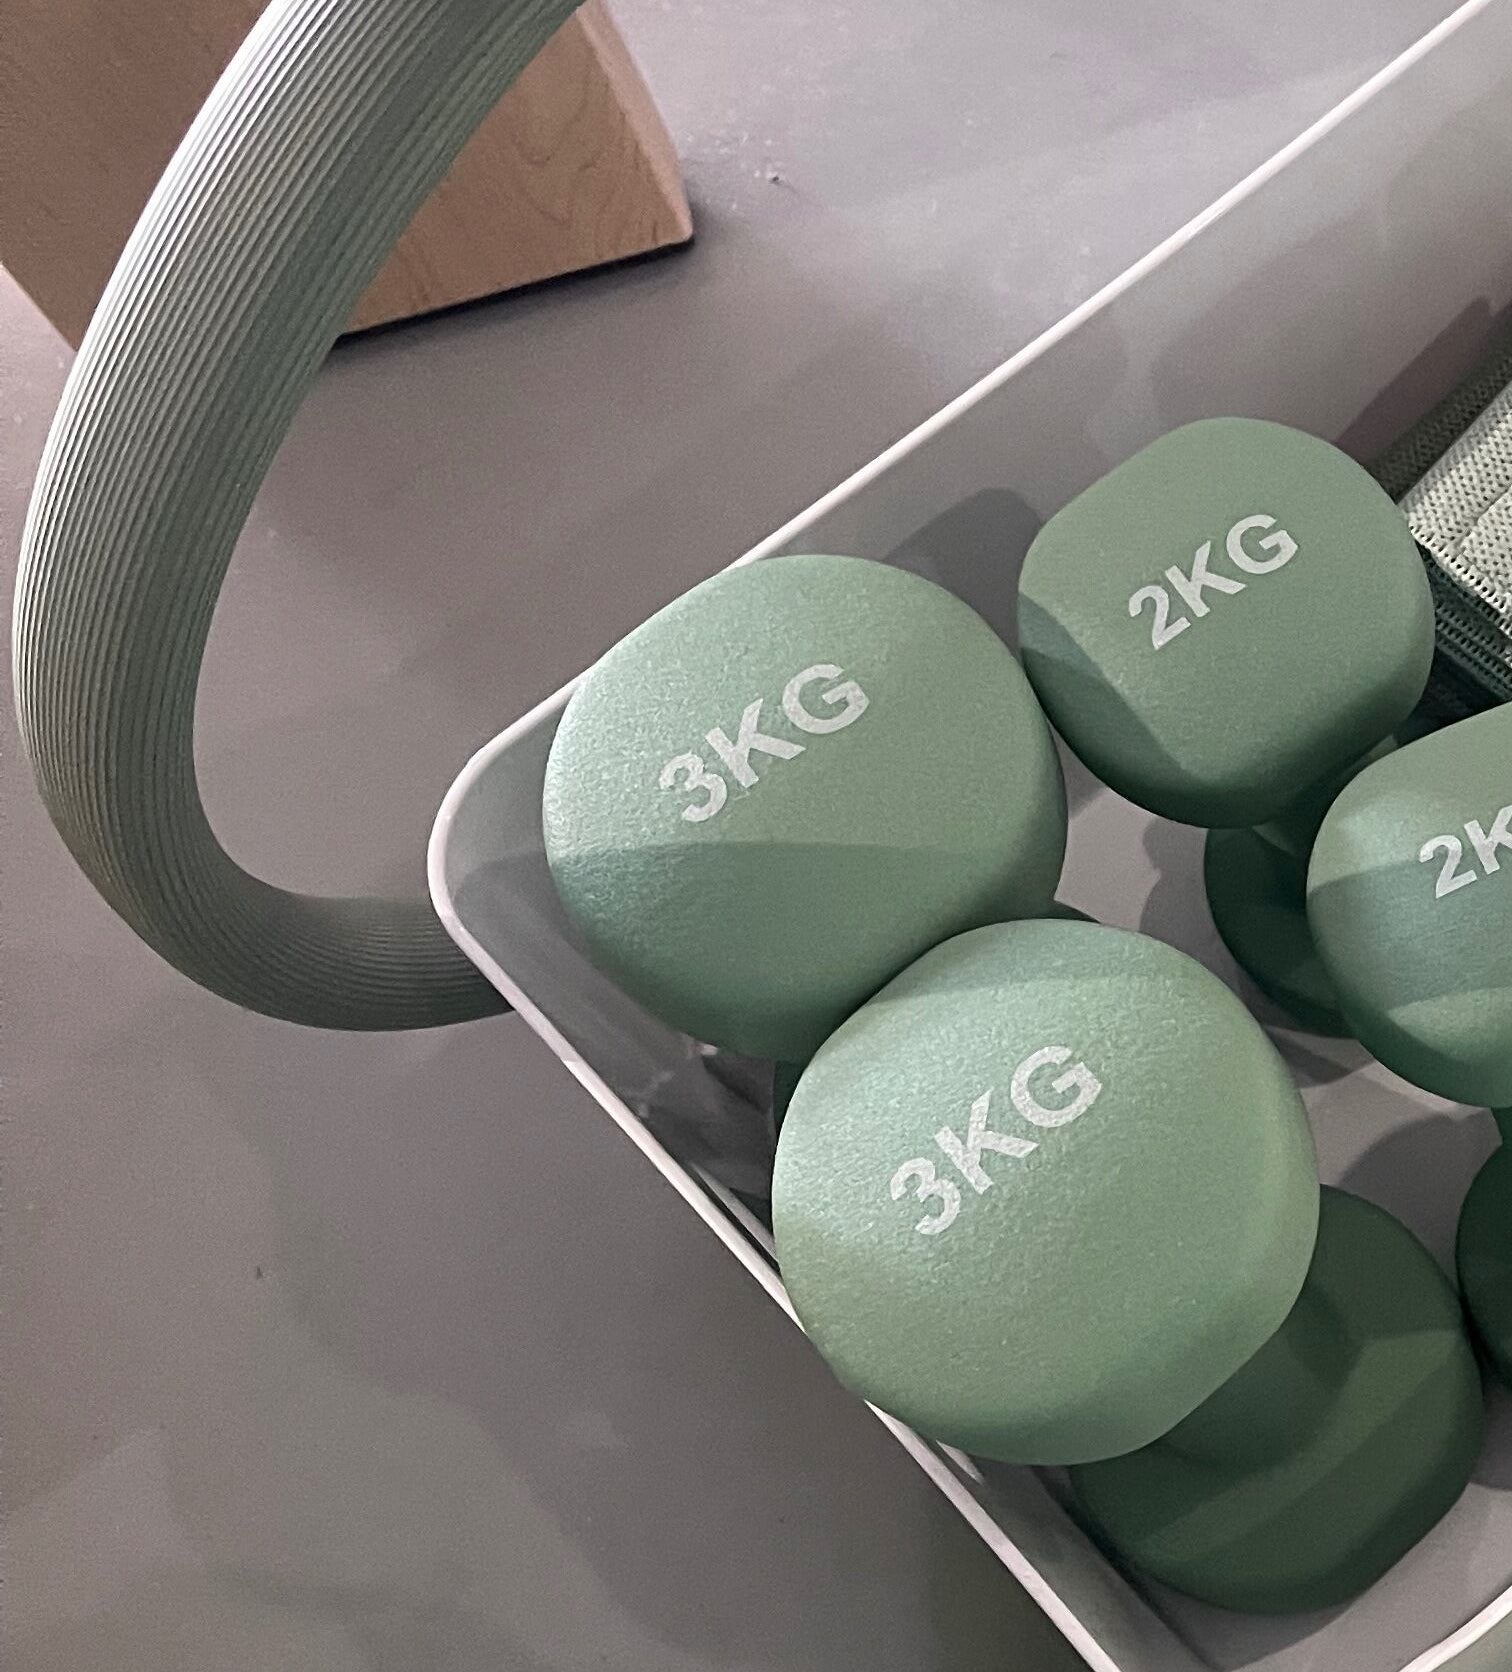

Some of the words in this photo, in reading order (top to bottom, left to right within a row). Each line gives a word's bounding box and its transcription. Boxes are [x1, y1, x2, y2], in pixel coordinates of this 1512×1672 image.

[1128, 513, 1300, 651] 2KG
[658, 663, 870, 822] 3KG
[890, 1045, 1102, 1236] 3KG
